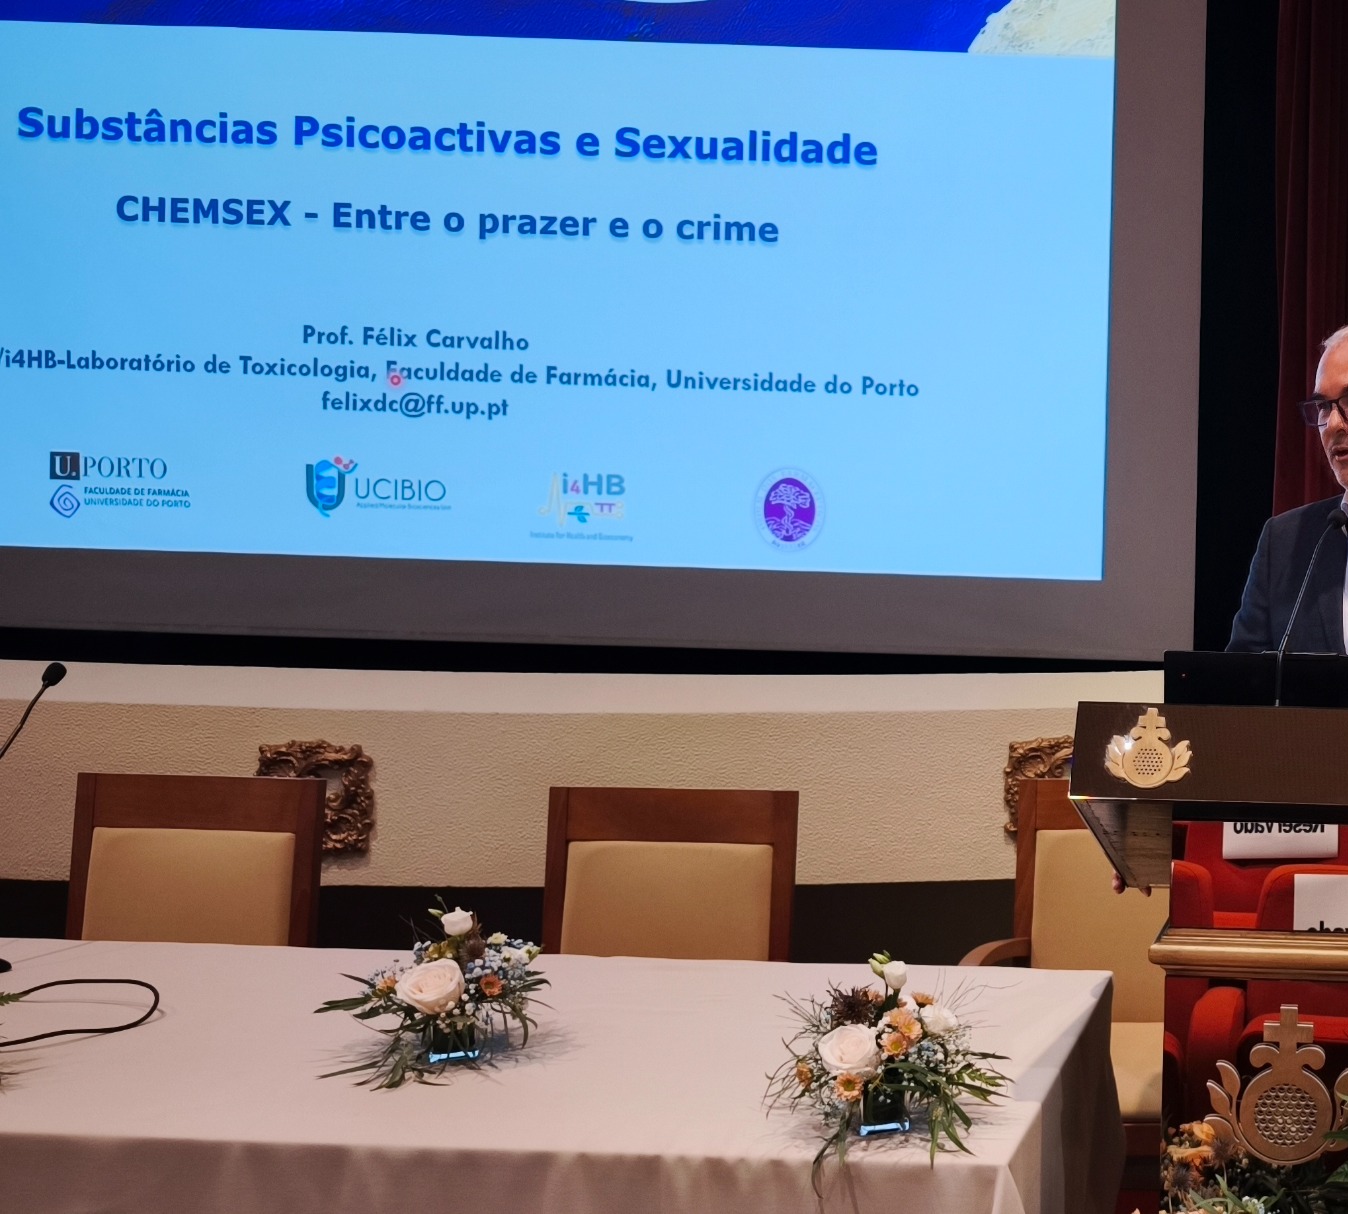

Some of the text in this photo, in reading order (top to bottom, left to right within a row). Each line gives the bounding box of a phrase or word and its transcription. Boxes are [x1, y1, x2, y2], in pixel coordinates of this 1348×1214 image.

[17, 106, 878, 166] Substâncias Psicoactivas e Sexualidade
[116, 195, 291, 227] CHEMSEX
[333, 202, 431, 232] Entre
[443, 211, 465, 233] o
[478, 212, 597, 240] prazer
[609, 217, 629, 238] e
[642, 218, 664, 239] o
[676, 213, 779, 243] crime
[302, 324, 529, 351] Prof. Félix Carvalho
[203, 353, 231, 374] de
[238, 355, 377, 383] Toxicologia,
[386, 360, 503, 383] Faculdade
[510, 363, 538, 384] de
[546, 365, 657, 392] Farmácia,
[666, 368, 816, 393] Universidade
[824, 374, 853, 395] do
[862, 375, 919, 397] Porto
[321, 390, 509, 421] felixdc@ff.up.pt
[83, 486, 132, 496] FACULDADE
[133, 487, 145, 497] DE
[355, 477, 447, 502] UCIBIO
[562, 472, 626, 496] i4HB
[145, 498, 160, 508] DO
